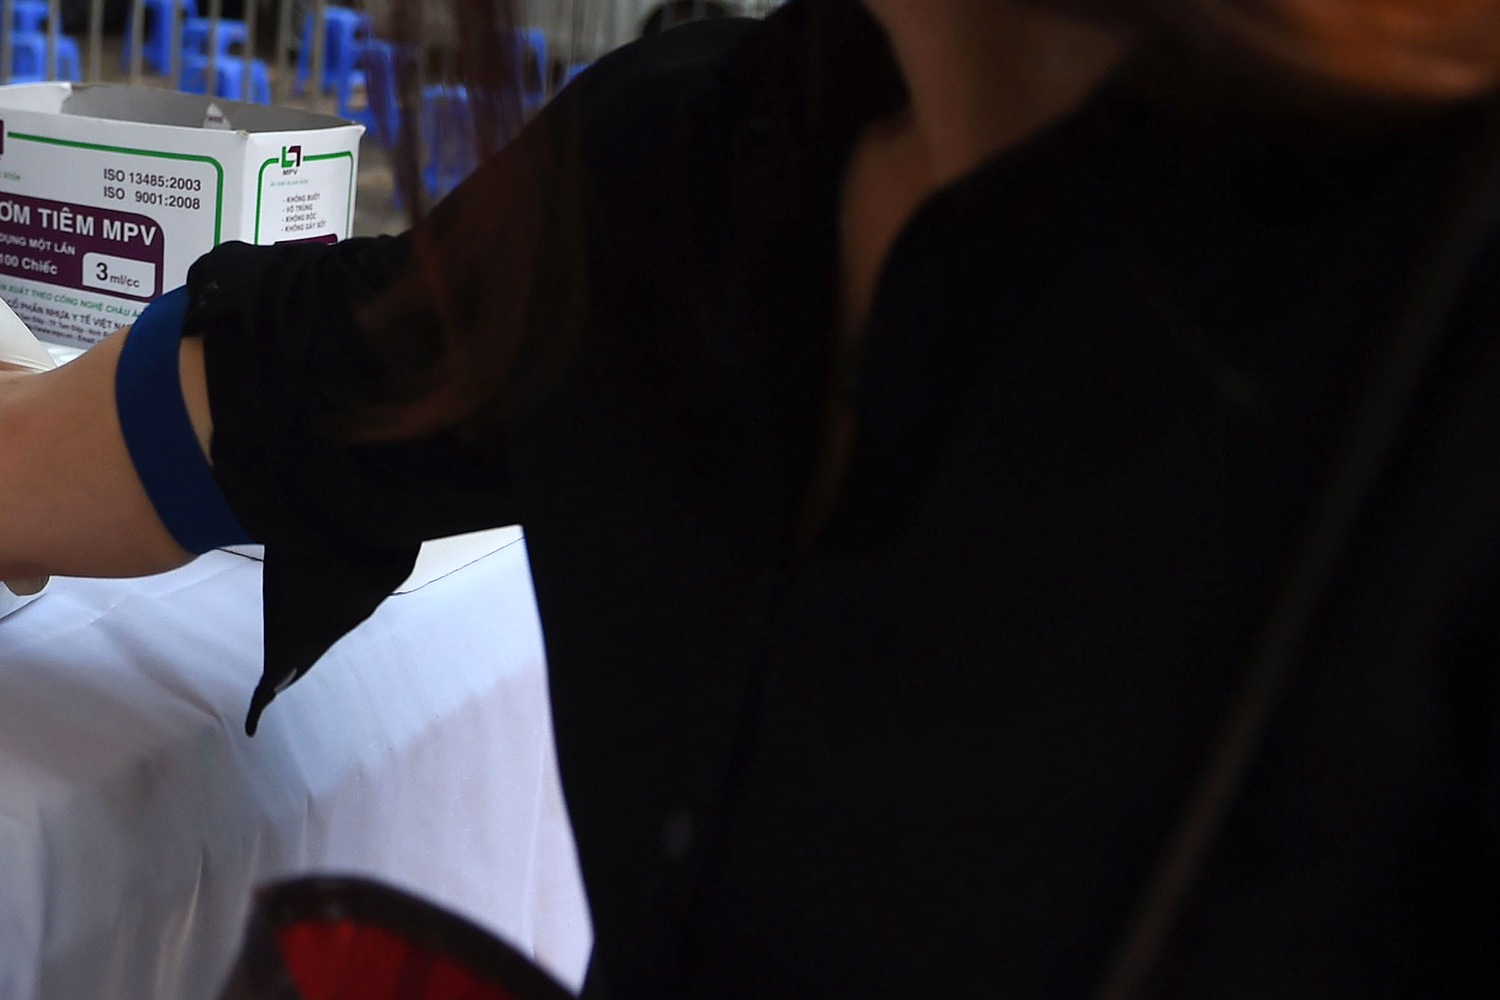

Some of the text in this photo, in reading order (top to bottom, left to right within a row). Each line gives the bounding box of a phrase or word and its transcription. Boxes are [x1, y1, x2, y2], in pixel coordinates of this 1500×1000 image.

[103, 168, 202, 191] ISO 13485:2003
[103, 186, 201, 210] ISO 9001:2008
[37, 207, 95, 236] TIÊM
[103, 219, 157, 246] MPV
[21, 257, 58, 275] Chiếc
[95, 262, 109, 282] 3
